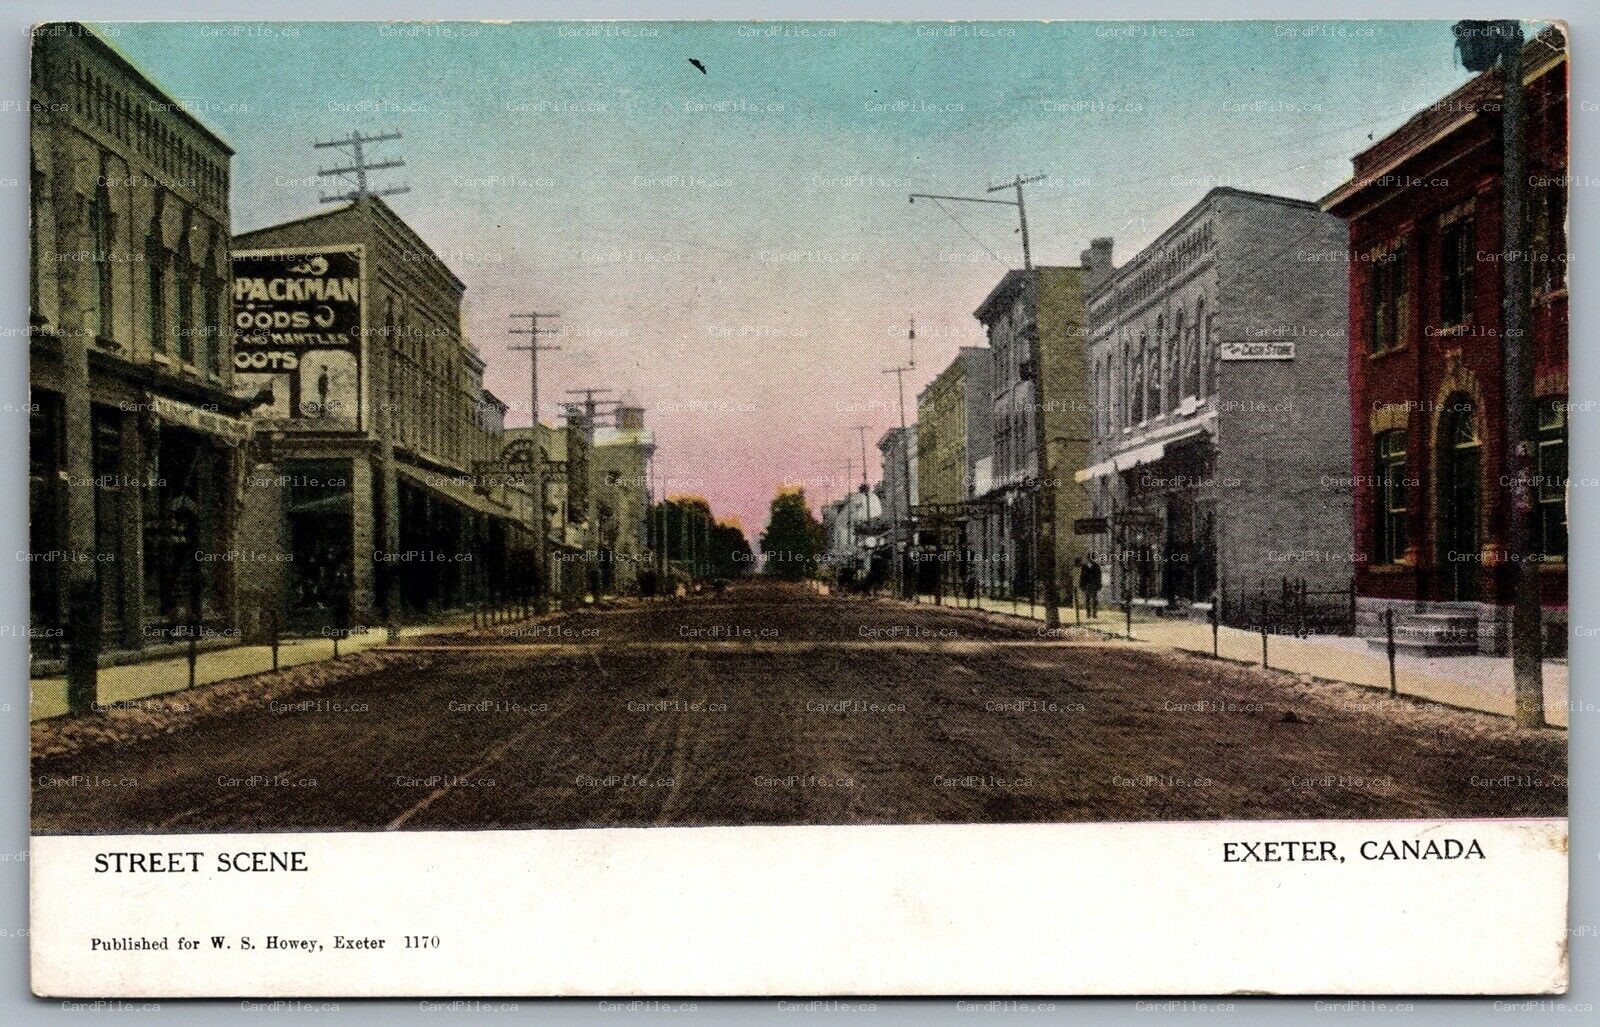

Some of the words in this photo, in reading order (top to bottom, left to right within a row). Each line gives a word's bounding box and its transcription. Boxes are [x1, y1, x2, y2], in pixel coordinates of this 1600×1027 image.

[234, 278, 359, 305] PACKMAN
[236, 311, 311, 329] OODS
[234, 351, 299, 369] OOTS
[1224, 841, 1346, 863] EXETER,
[1360, 839, 1485, 860] CANADA
[95, 852, 204, 872] STREET
[218, 852, 308, 872] SCENE
[92, 937, 168, 950] Published
[178, 937, 200, 950] for
[211, 937, 231, 950] W.
[241, 937, 256, 950] S.
[266, 936, 324, 952] Howey,
[334, 936, 386, 949] Exeter
[405, 936, 440, 948] 1170
